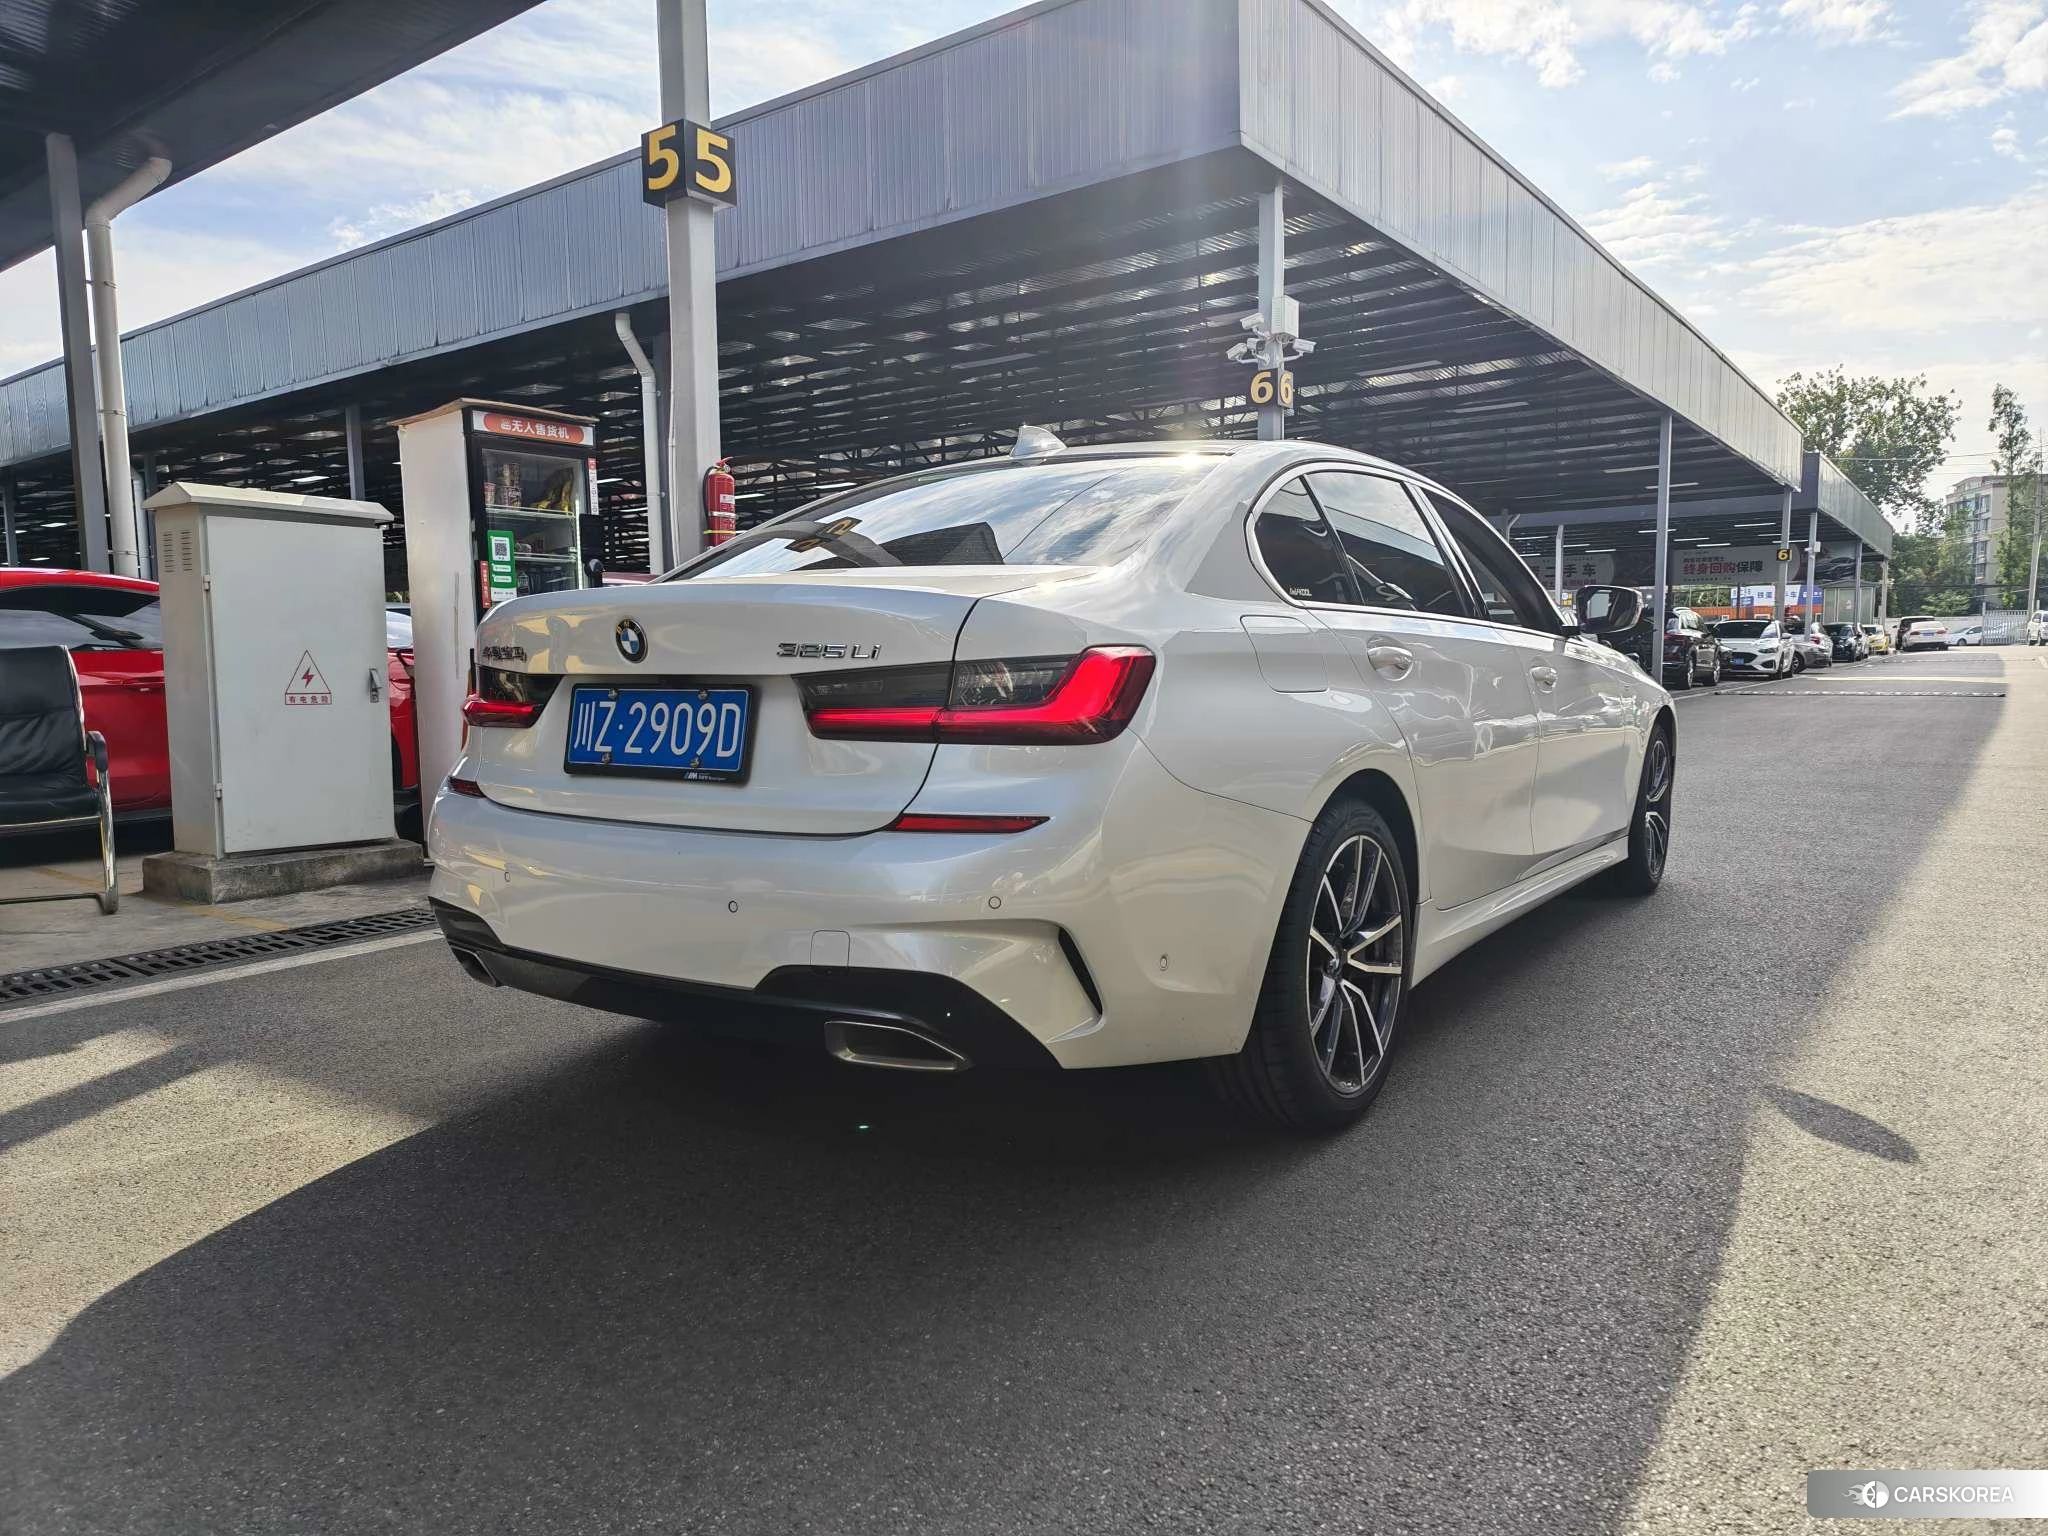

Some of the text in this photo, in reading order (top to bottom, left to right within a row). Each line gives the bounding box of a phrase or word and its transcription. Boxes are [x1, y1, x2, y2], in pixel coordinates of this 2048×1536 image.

[648, 124, 679, 190] 5
[696, 128, 731, 193] 5
[1251, 371, 1273, 404] 6
[1280, 371, 1294, 405] 6
[511, 420, 570, 440] 无人售货机
[1777, 549, 1790, 561] 6
[288, 695, 329, 704] 有电危险
